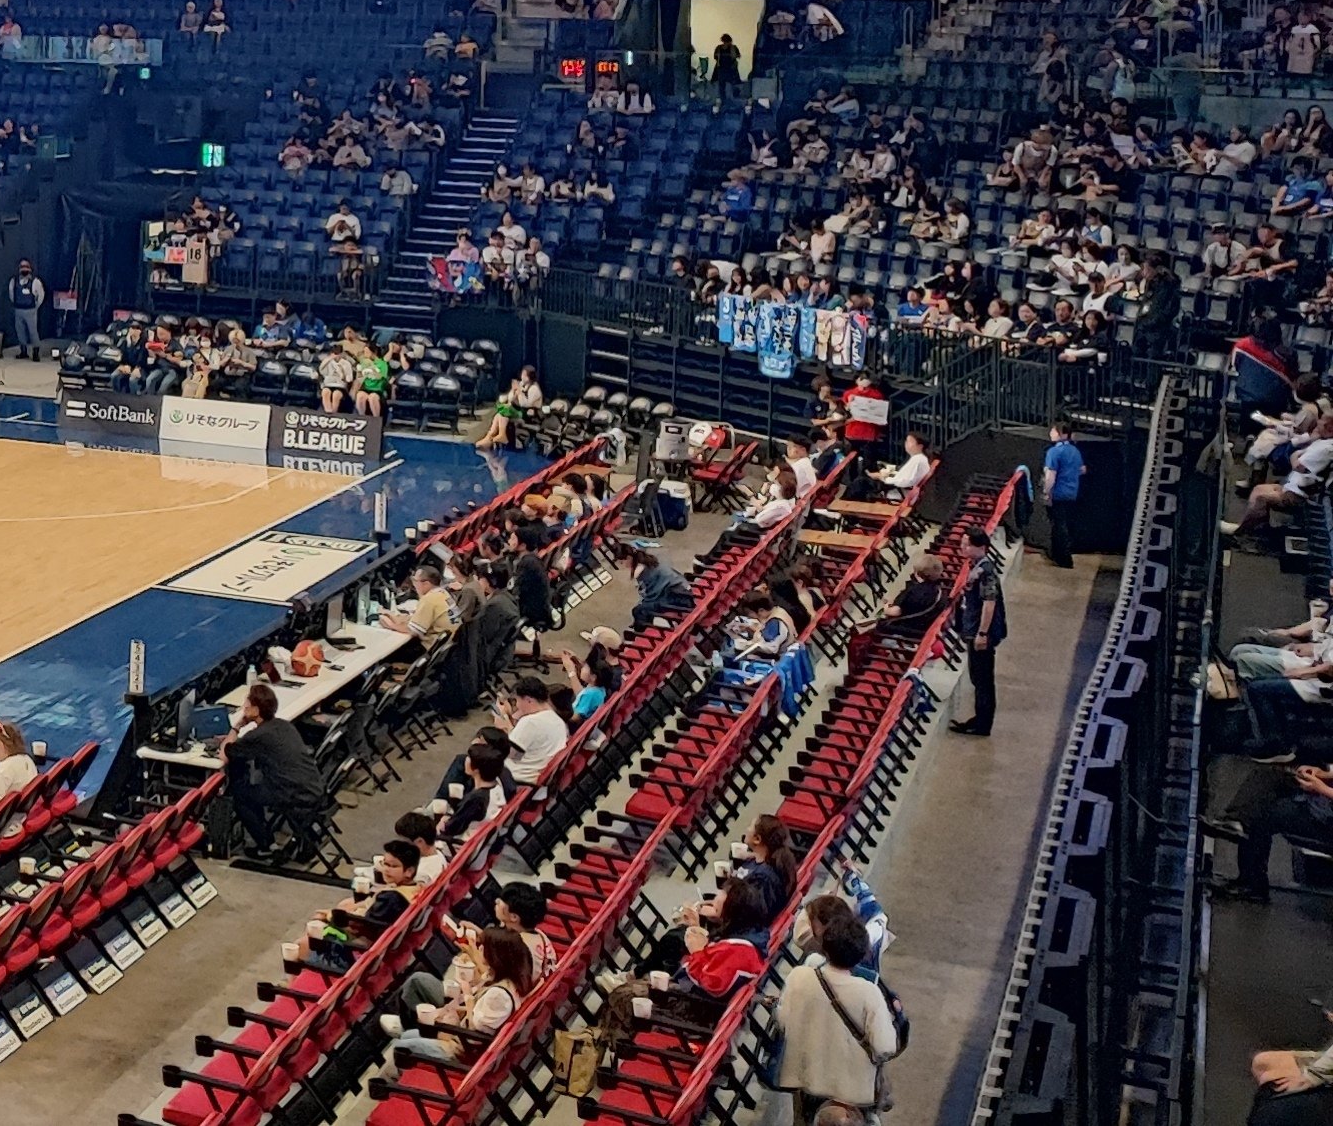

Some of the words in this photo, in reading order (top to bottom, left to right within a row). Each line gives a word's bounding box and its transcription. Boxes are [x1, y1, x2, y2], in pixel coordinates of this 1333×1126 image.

[88, 402, 155, 426] SoftBank
[185, 412, 261, 432] りそなグループ
[300, 410, 367, 432] りそなグループ
[283, 429, 367, 456] B.LEAGUE
